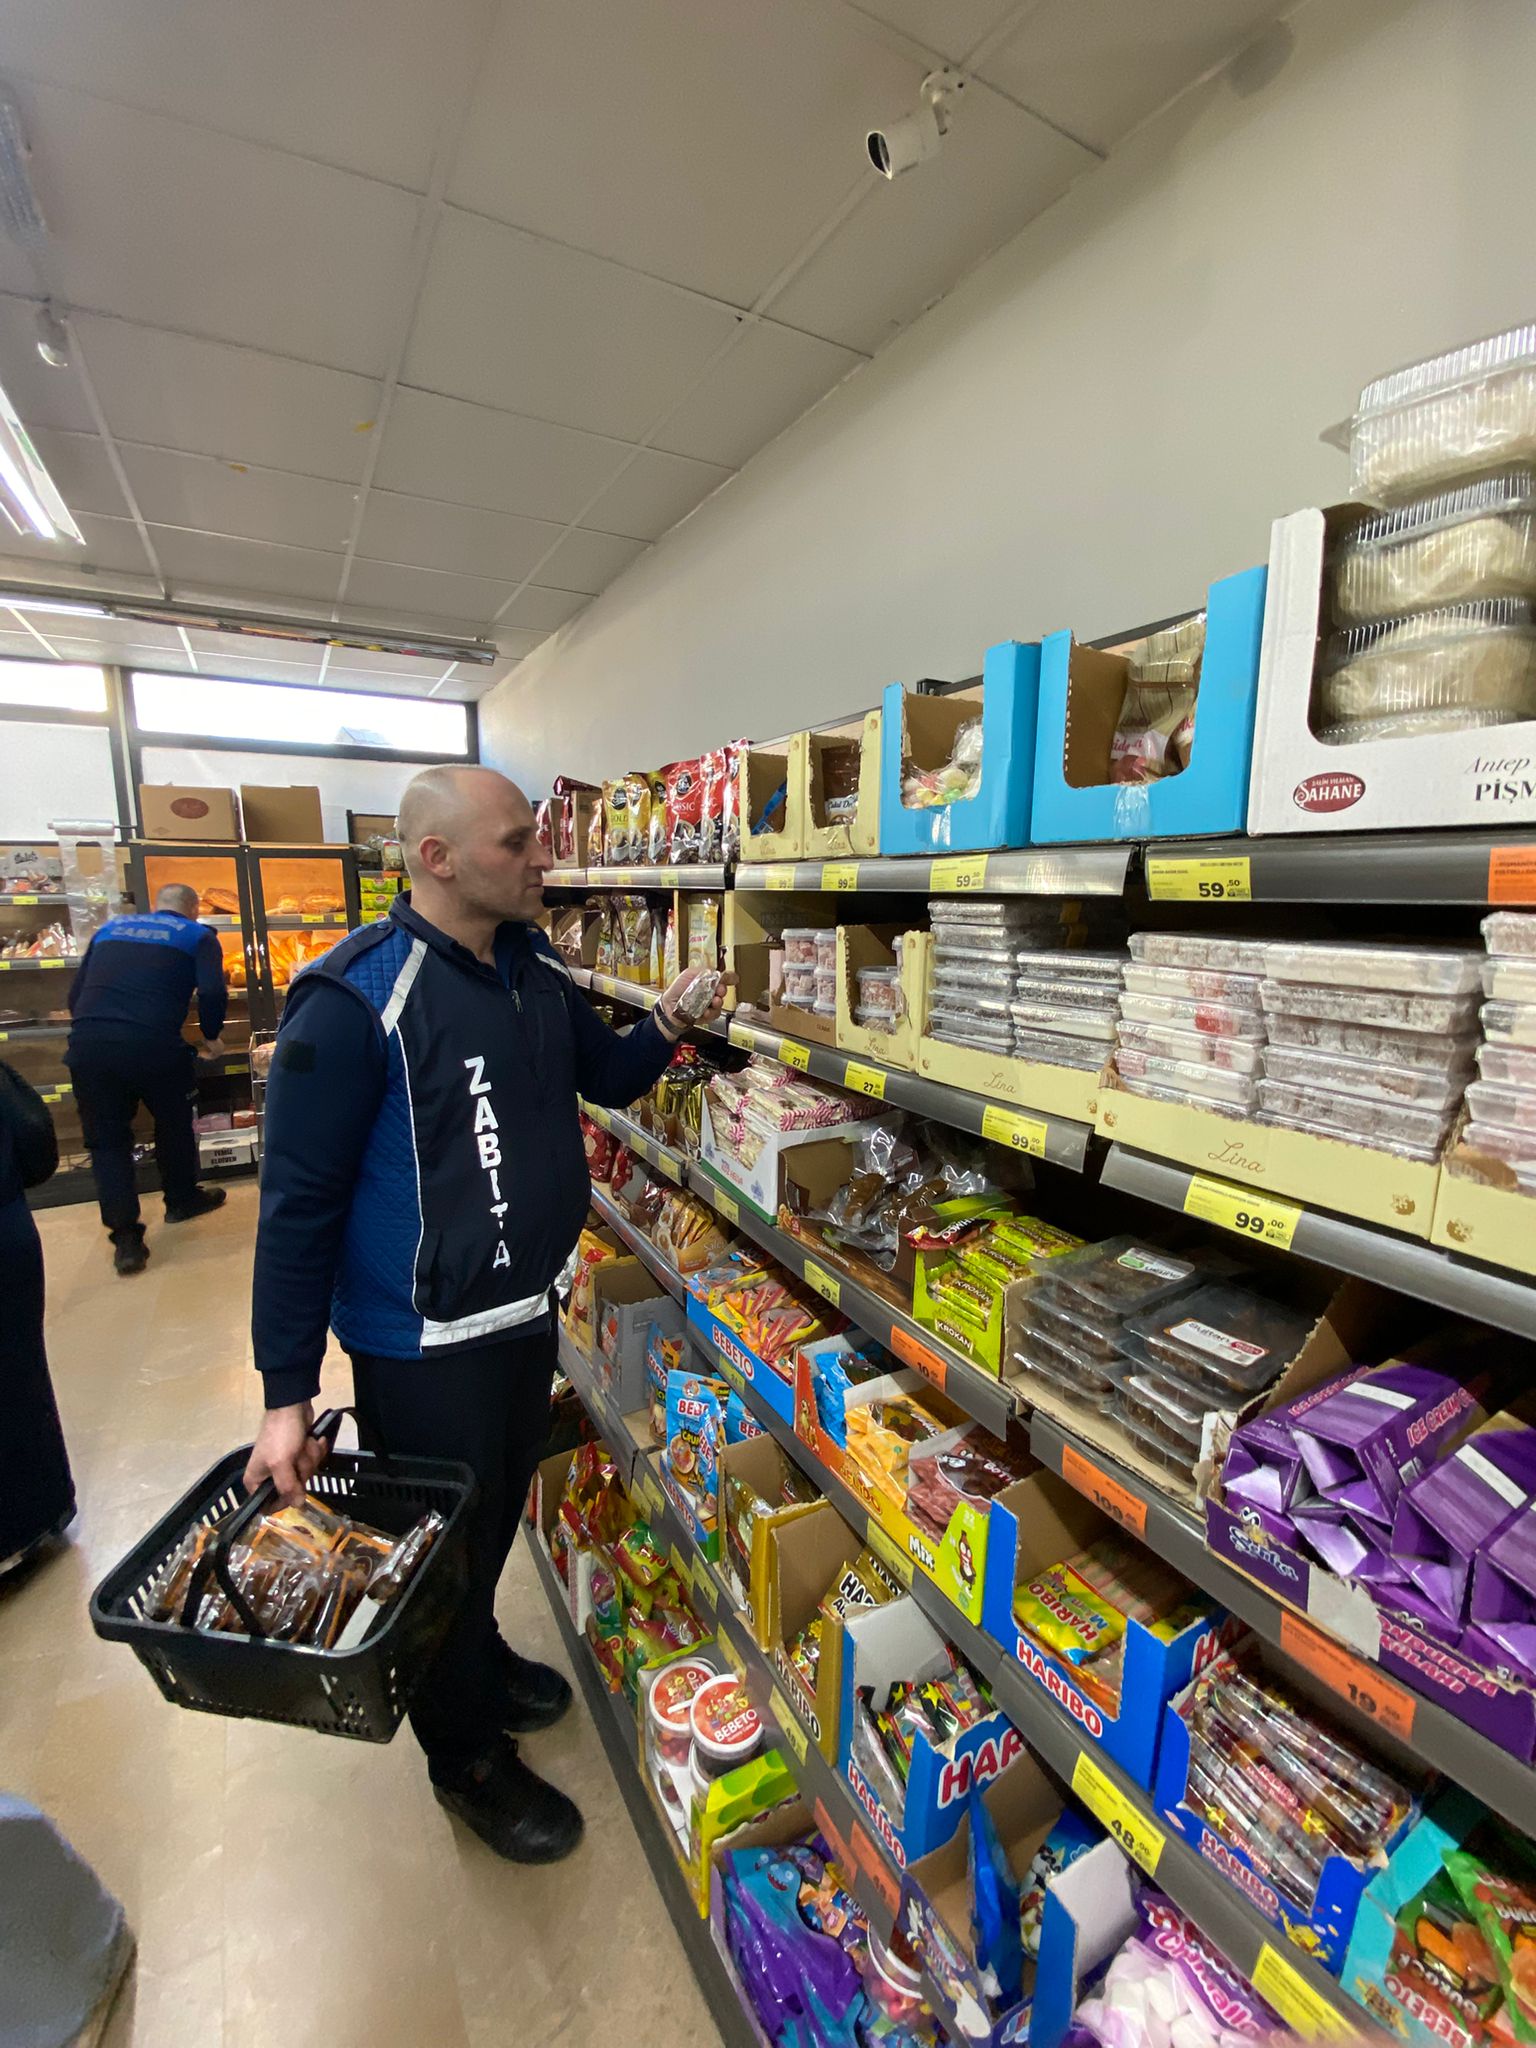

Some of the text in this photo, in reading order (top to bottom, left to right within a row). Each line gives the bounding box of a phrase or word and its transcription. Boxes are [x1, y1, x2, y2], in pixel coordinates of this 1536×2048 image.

[1464, 756, 1531, 775] Antep
[1294, 780, 1363, 808] ŞAHANE
[956, 875, 971, 887] 59
[1199, 882, 1225, 898] 59
[863, 1081, 874, 1094] 27
[983, 1071, 1017, 1095] Lina
[1011, 1133, 1029, 1149] 99
[464, 1056, 512, 1269] ZABITA
[1206, 1139, 1266, 1175] Lina
[1235, 1212, 1265, 1234] 99
[938, 1321, 971, 1349] KROKAN
[712, 1324, 755, 1381] BEBETO
[1406, 1417, 1429, 1449] ICE
[1028, 1583, 1099, 1645] HARIBO
[775, 1648, 822, 1742] HARIBO
[1017, 1636, 1103, 1738] HARIBO
[714, 1709, 758, 1743] BEBETO
[848, 1759, 907, 1869] HARIBO
[1111, 1819, 1136, 1850] 48
